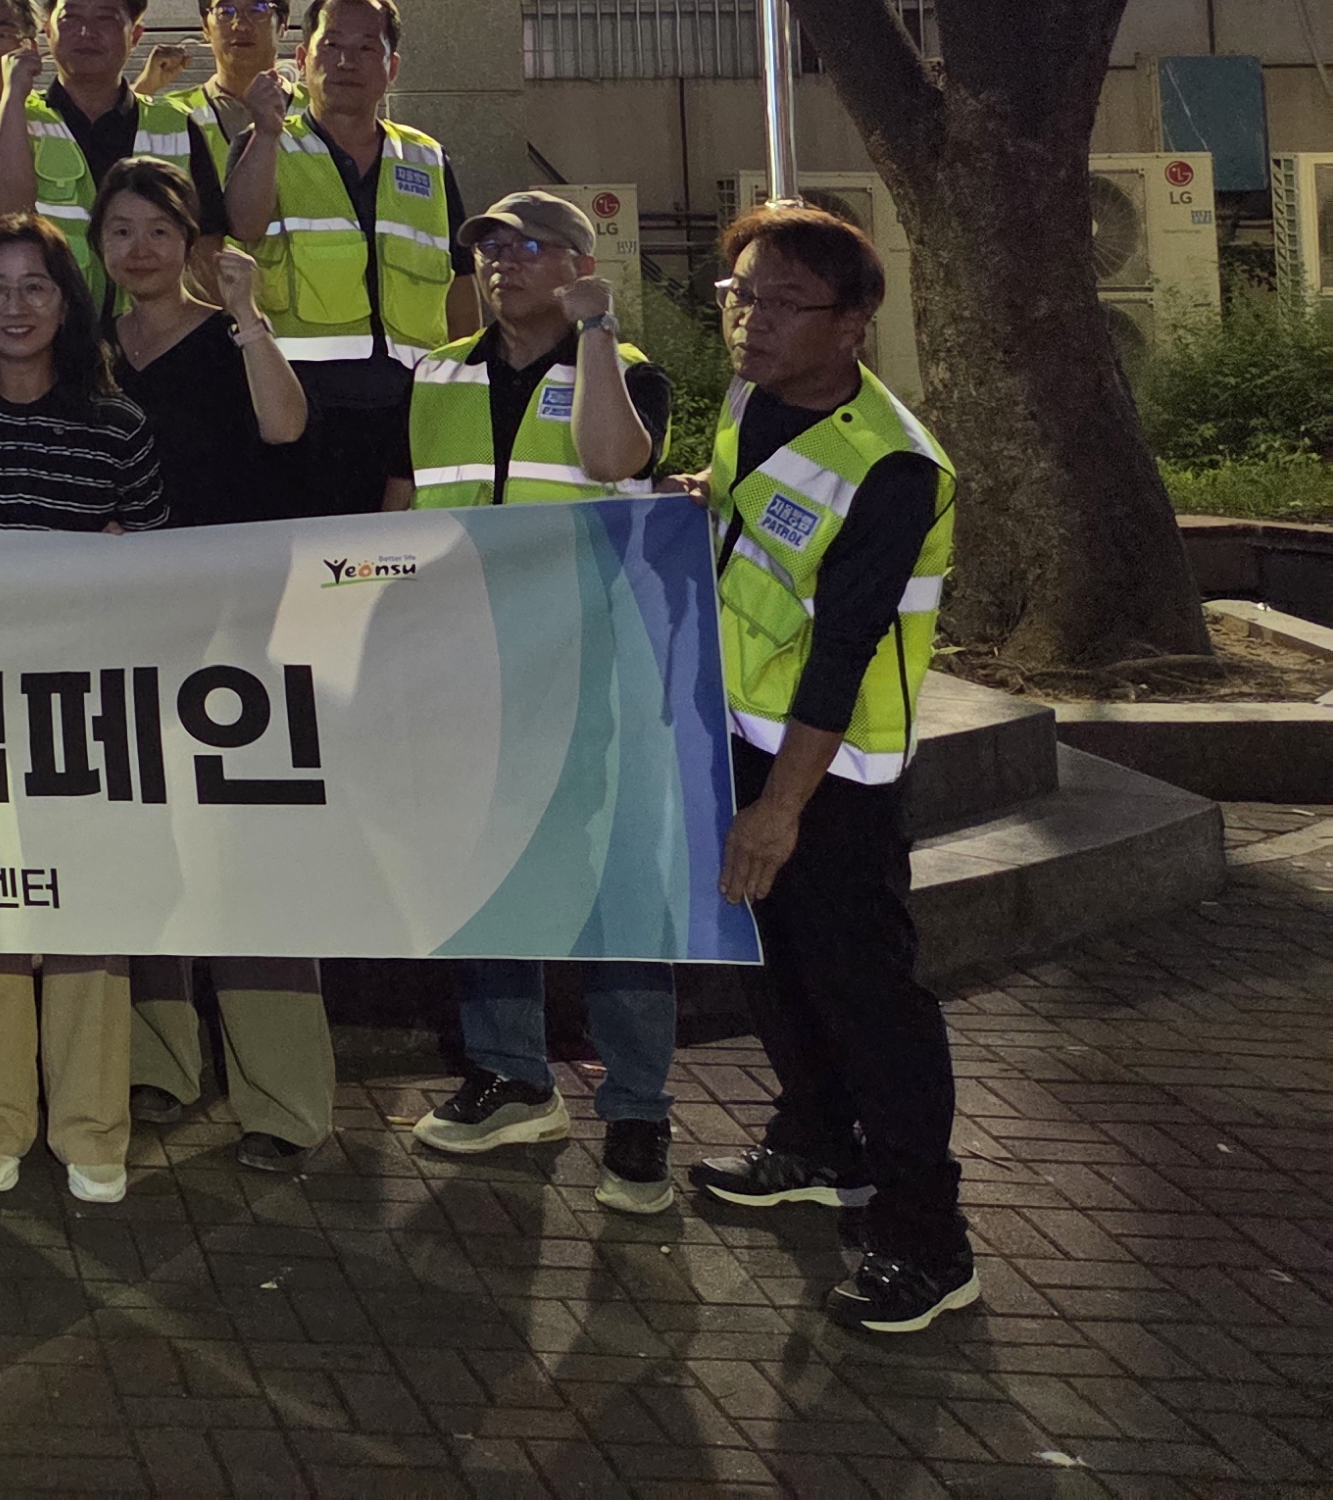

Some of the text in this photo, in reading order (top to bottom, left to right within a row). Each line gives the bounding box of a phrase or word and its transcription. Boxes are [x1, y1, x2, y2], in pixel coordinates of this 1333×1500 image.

[397, 181, 431, 198] PATROL
[1169, 191, 1193, 205] LG
[596, 222, 619, 236] LG
[766, 493, 820, 535] 자율방범
[762, 516, 805, 549] PATROL
[323, 558, 416, 585] Yeonsu
